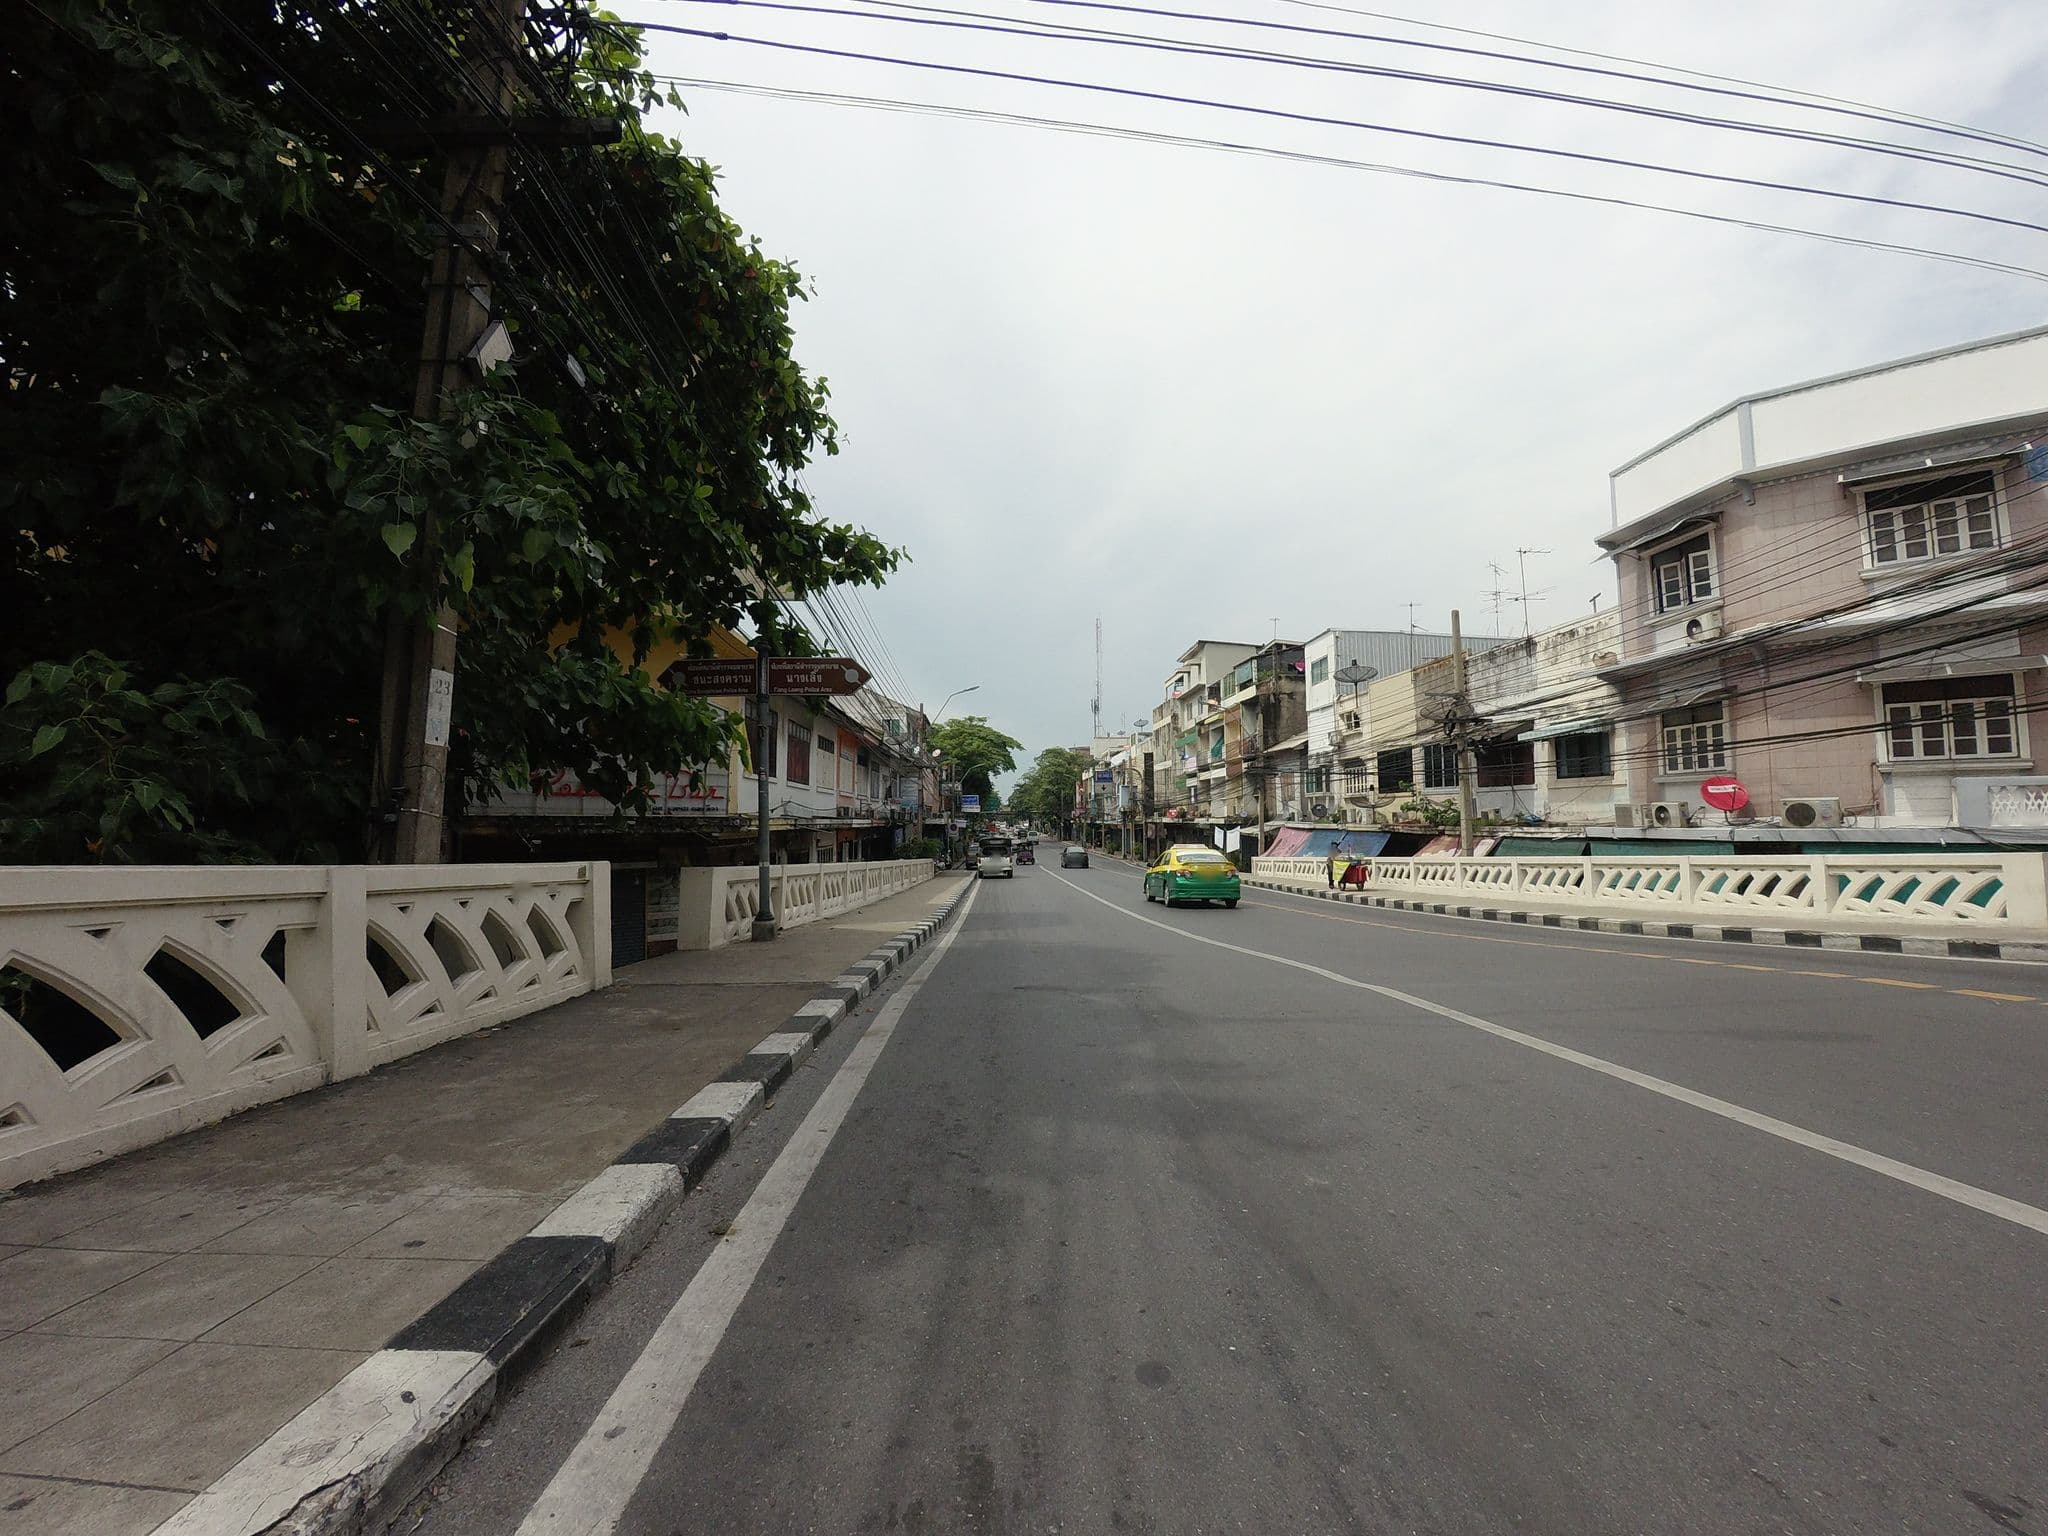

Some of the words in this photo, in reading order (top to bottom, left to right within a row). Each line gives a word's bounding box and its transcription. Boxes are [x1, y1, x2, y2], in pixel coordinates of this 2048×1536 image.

[693, 674, 752, 685] ชนะสงคราม
[786, 670, 823, 684] นางเลิ้ง
